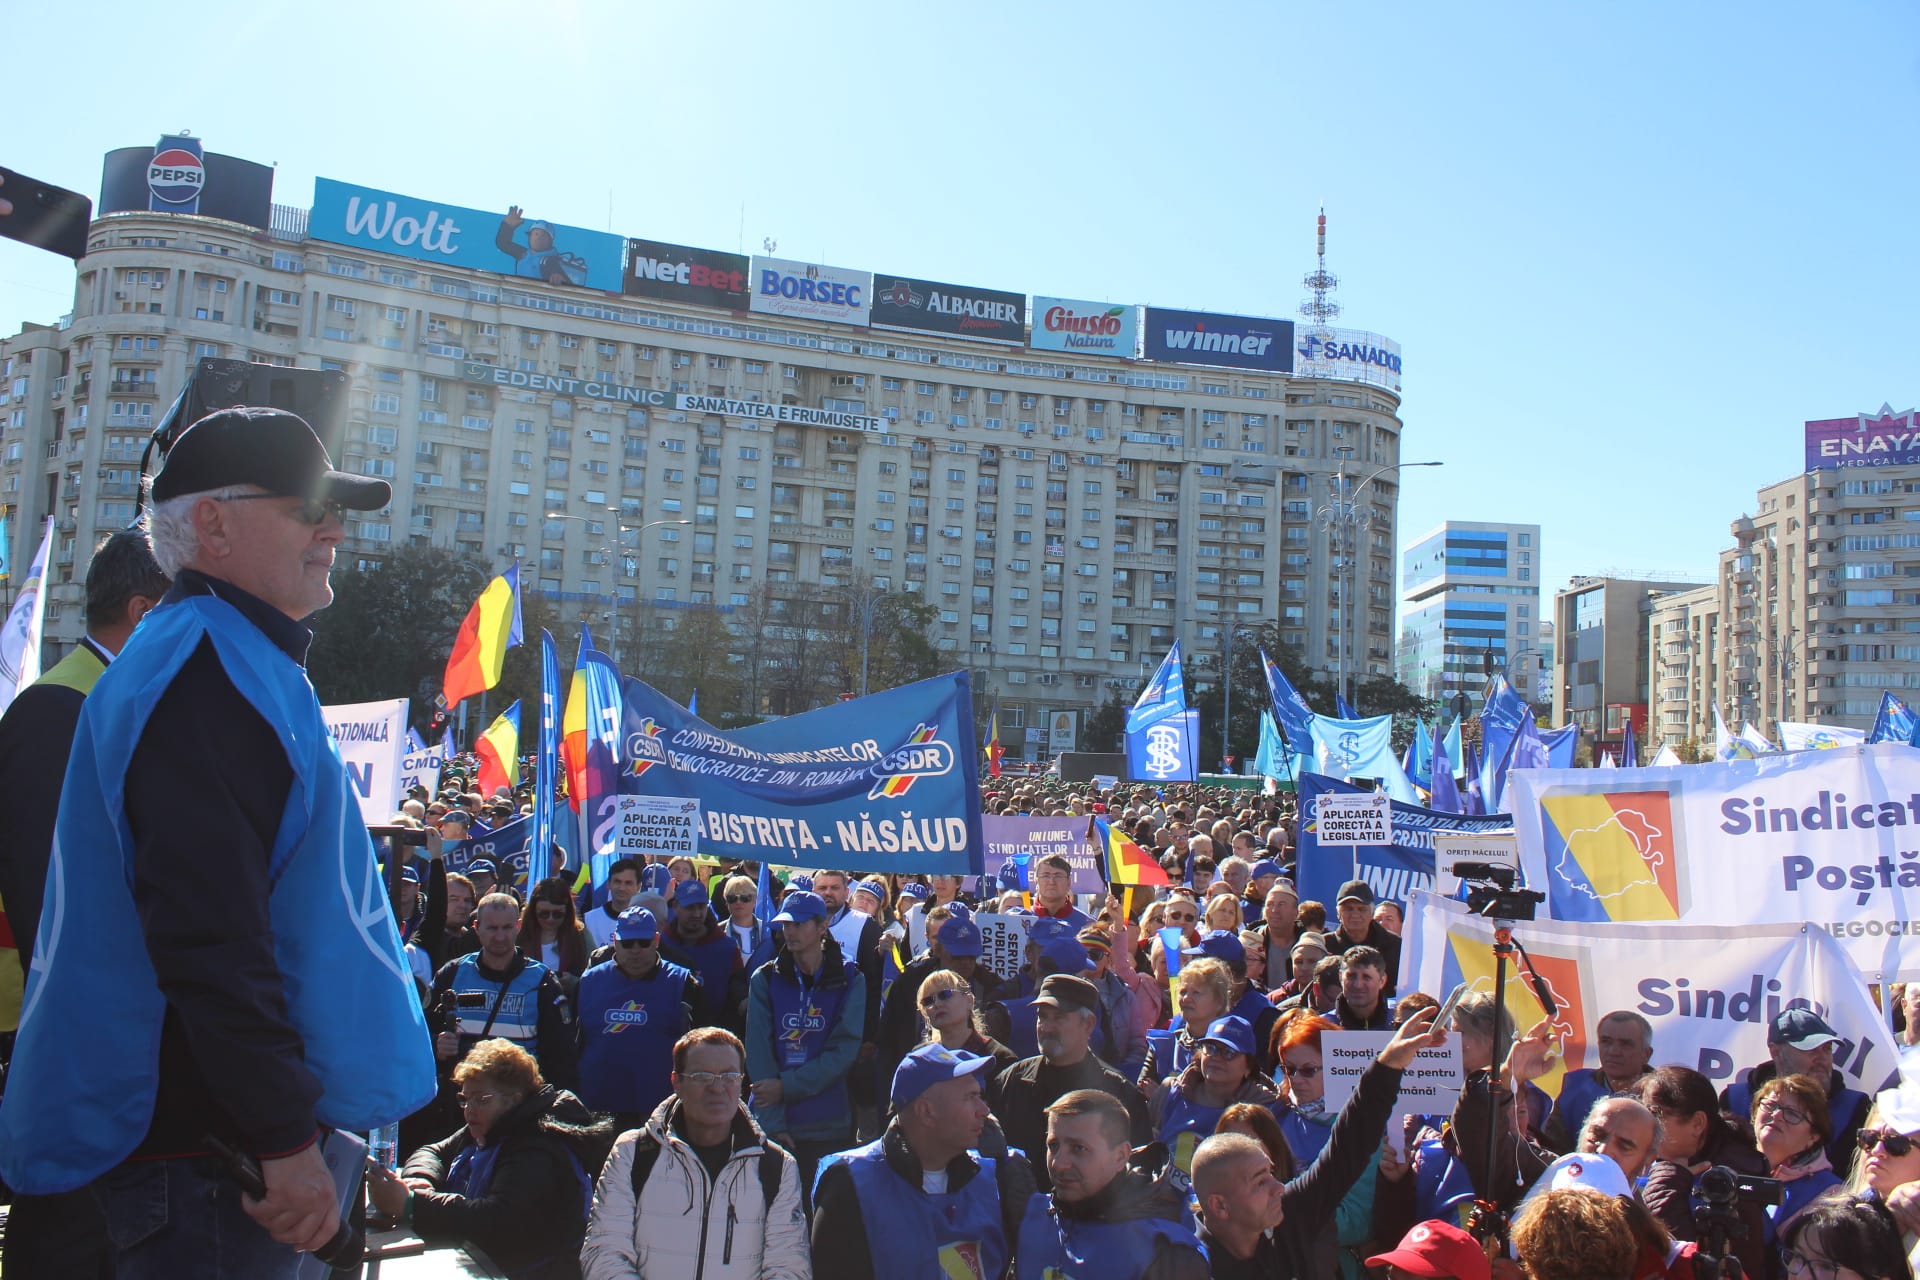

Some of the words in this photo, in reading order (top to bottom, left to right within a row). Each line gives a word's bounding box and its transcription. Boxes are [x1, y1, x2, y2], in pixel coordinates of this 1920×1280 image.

[150, 168, 202, 185] PEPSI
[345, 196, 460, 254] Wolt
[635, 256, 744, 293] NetBet
[760, 268, 861, 308] BORSEC
[927, 291, 1020, 325] ALBACHER
[1044, 306, 1122, 336] Giusto
[1064, 333, 1115, 349] Natura
[1165, 323, 1272, 357] winner
[1324, 341, 1402, 375] SANADOR
[493, 368, 580, 393] EDENT
[584, 383, 665, 405] CLINIC
[685, 396, 775, 418] SĂNĂTATEA
[779, 406, 788, 419] E
[328, 718, 388, 746] AȚIONALĂ
[667, 750, 769, 783] DEMOCRATICE
[767, 770, 795, 786] DIN
[882, 749, 943, 771] CSDR
[623, 813, 691, 827] APLICAREA
[1323, 809, 1383, 819] APLICAREA
[1375, 820, 1383, 829] A
[681, 828, 690, 838] A
[707, 811, 819, 859] BISTRIȚA
[836, 810, 968, 853] NĂSĂUD
[1028, 830, 1074, 842] UNIUNEA
[1322, 831, 1385, 842] LEGISLAȚIEI
[620, 837, 692, 852] LEGISLAȚIEI
[988, 842, 1067, 855] SINDICATELOR
[1073, 843, 1096, 856] LIB
[1007, 932, 1018, 978] SERVIC
[610, 1011, 642, 1023] CSDR
[1332, 1048, 1374, 1060] Stopați
[1417, 1068, 1456, 1078] pentru
